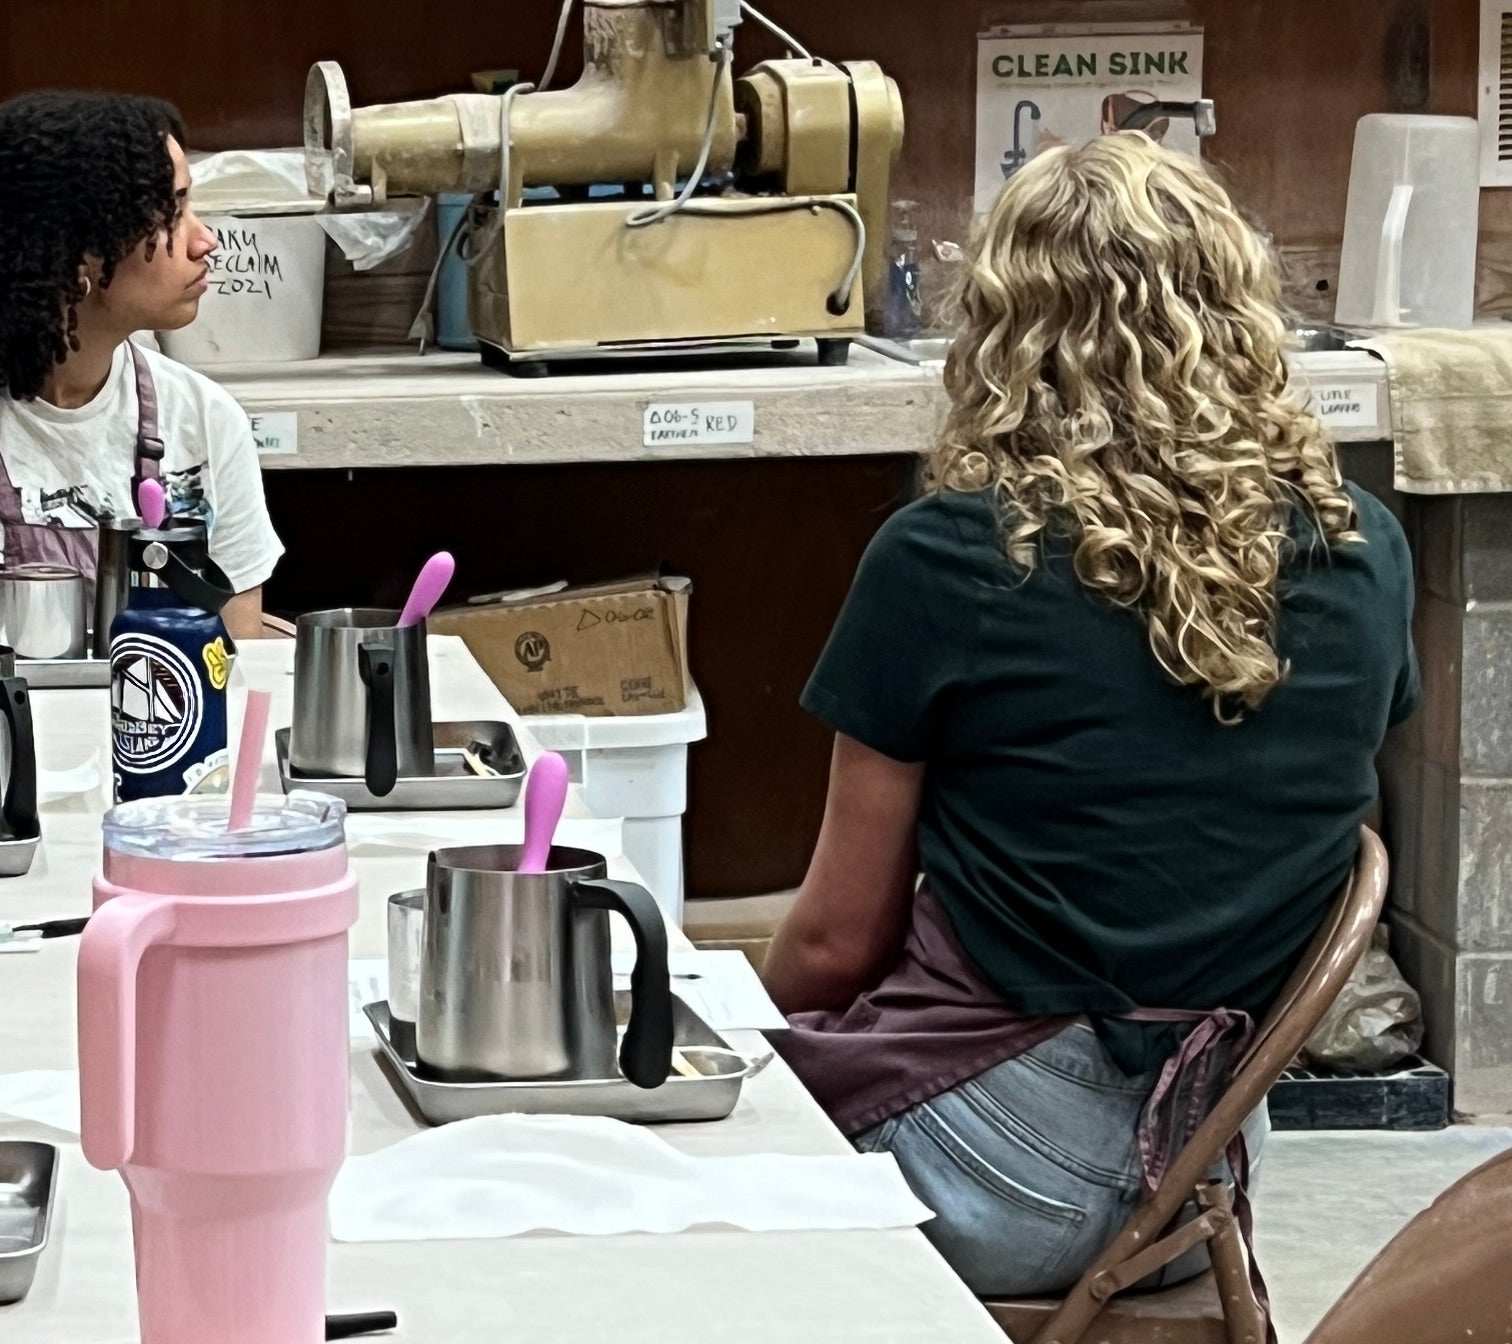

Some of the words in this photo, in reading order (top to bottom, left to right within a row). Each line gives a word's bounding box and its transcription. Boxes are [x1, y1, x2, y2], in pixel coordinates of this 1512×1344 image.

[992, 53, 1097, 78] CLEAN
[1108, 51, 1189, 76] SINK
[705, 415, 738, 432] RED
